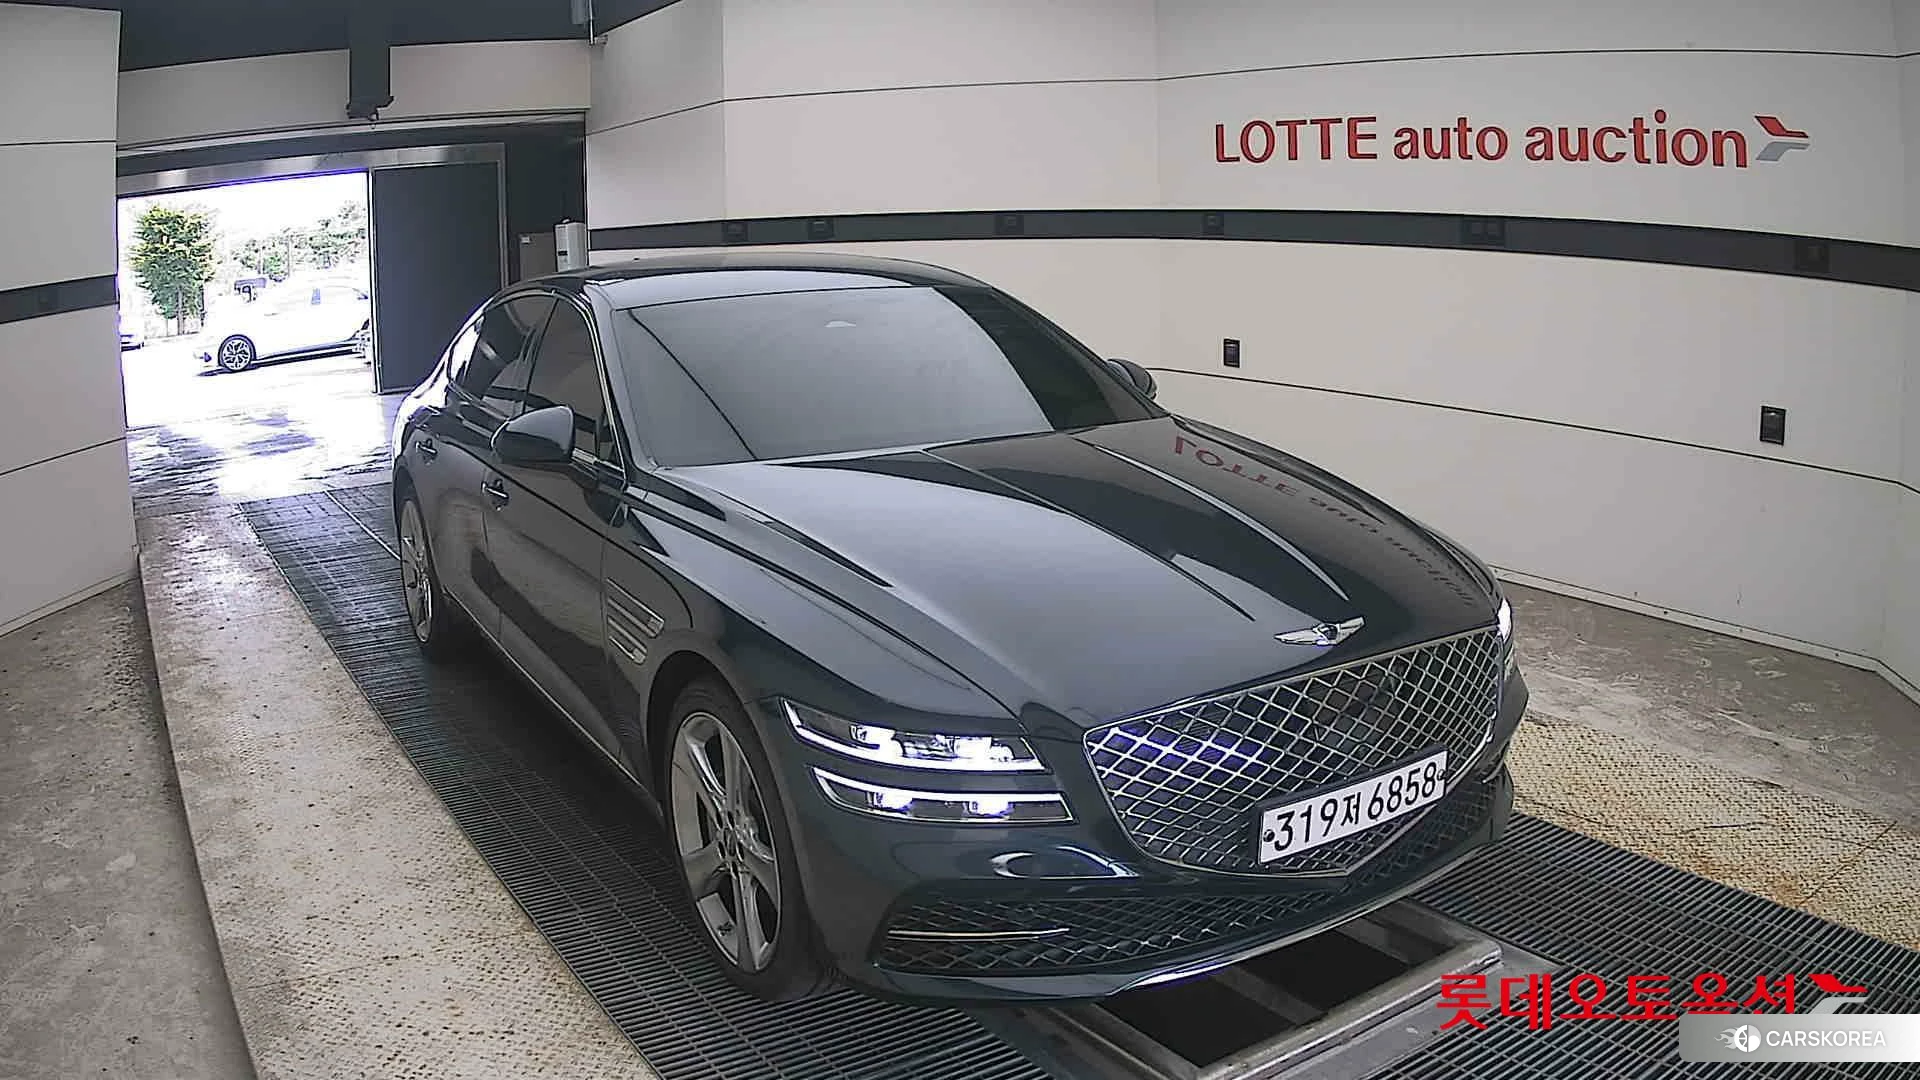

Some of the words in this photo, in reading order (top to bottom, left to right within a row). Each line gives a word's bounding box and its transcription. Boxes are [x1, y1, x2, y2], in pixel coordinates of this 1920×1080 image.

[1215, 117, 1377, 163] LOTTE
[1393, 118, 1509, 161] auto
[1524, 109, 1748, 168] auction
